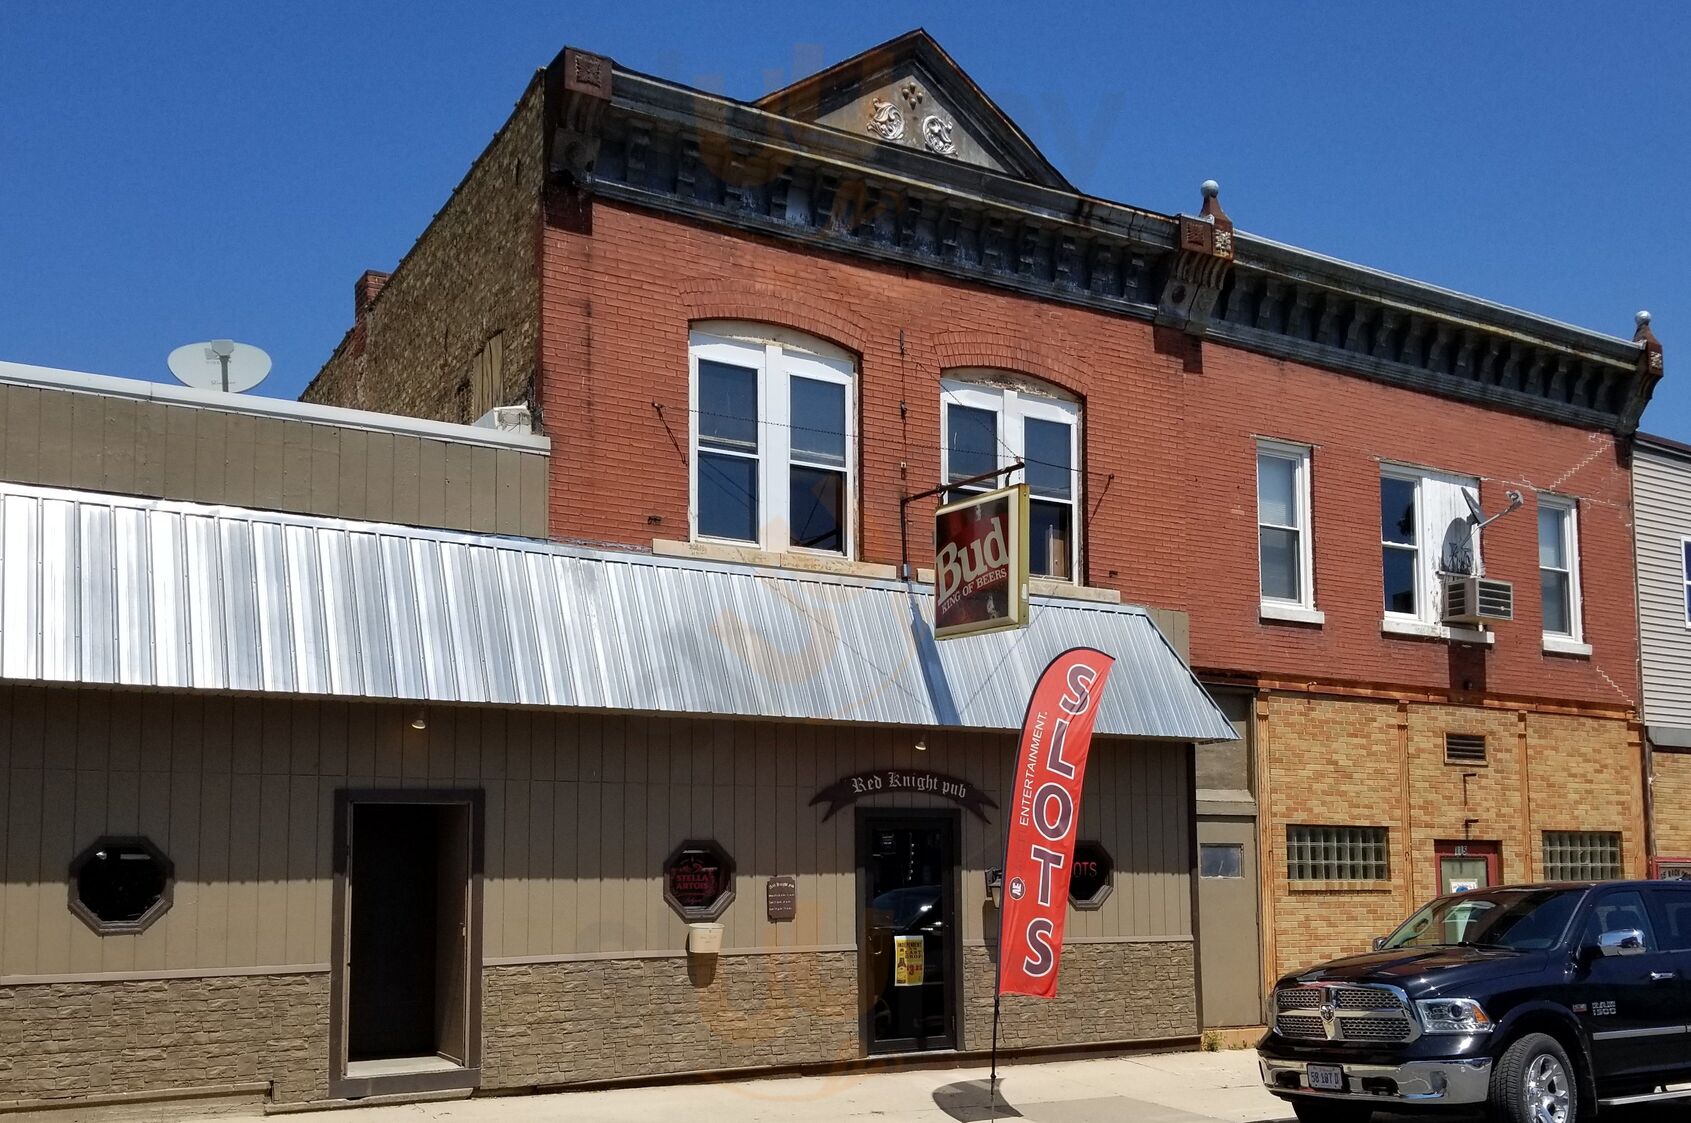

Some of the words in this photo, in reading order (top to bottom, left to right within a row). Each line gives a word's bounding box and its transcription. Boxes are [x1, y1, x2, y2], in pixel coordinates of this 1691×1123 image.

[936, 516, 1009, 606] Bud
[942, 591, 961, 614] KING
[963, 583, 975, 597] OF
[976, 567, 1008, 588] BEERS
[851, 775, 882, 793] Red
[888, 771, 938, 791] Knight
[942, 780, 966, 798] pub
[1023, 663, 1097, 977] SLOTS
